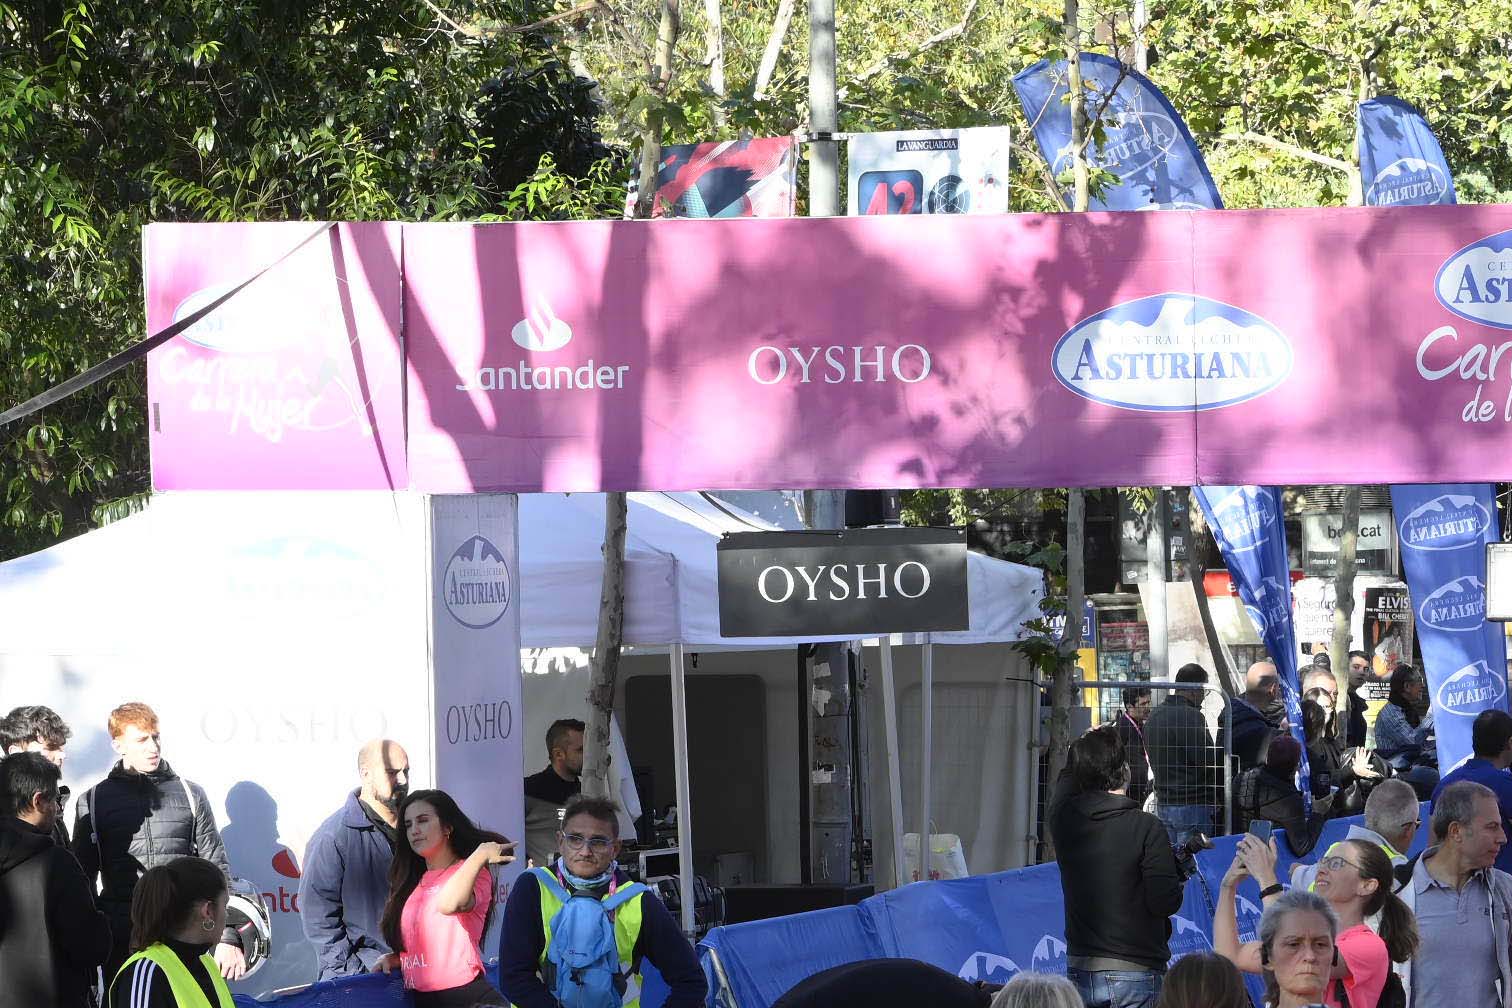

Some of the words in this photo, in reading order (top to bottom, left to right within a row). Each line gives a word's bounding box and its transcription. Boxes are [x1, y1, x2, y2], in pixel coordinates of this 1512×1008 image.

[455, 359, 630, 392] Santander
[748, 344, 932, 386] OYSHO
[1070, 337, 1273, 382] ASTURIANA
[1461, 384, 1496, 422] de
[450, 571, 507, 606] ASTURIANA
[757, 561, 932, 603] OYSHO
[1378, 596, 1411, 609] ELVIS
[446, 701, 513, 745] OYSHO
